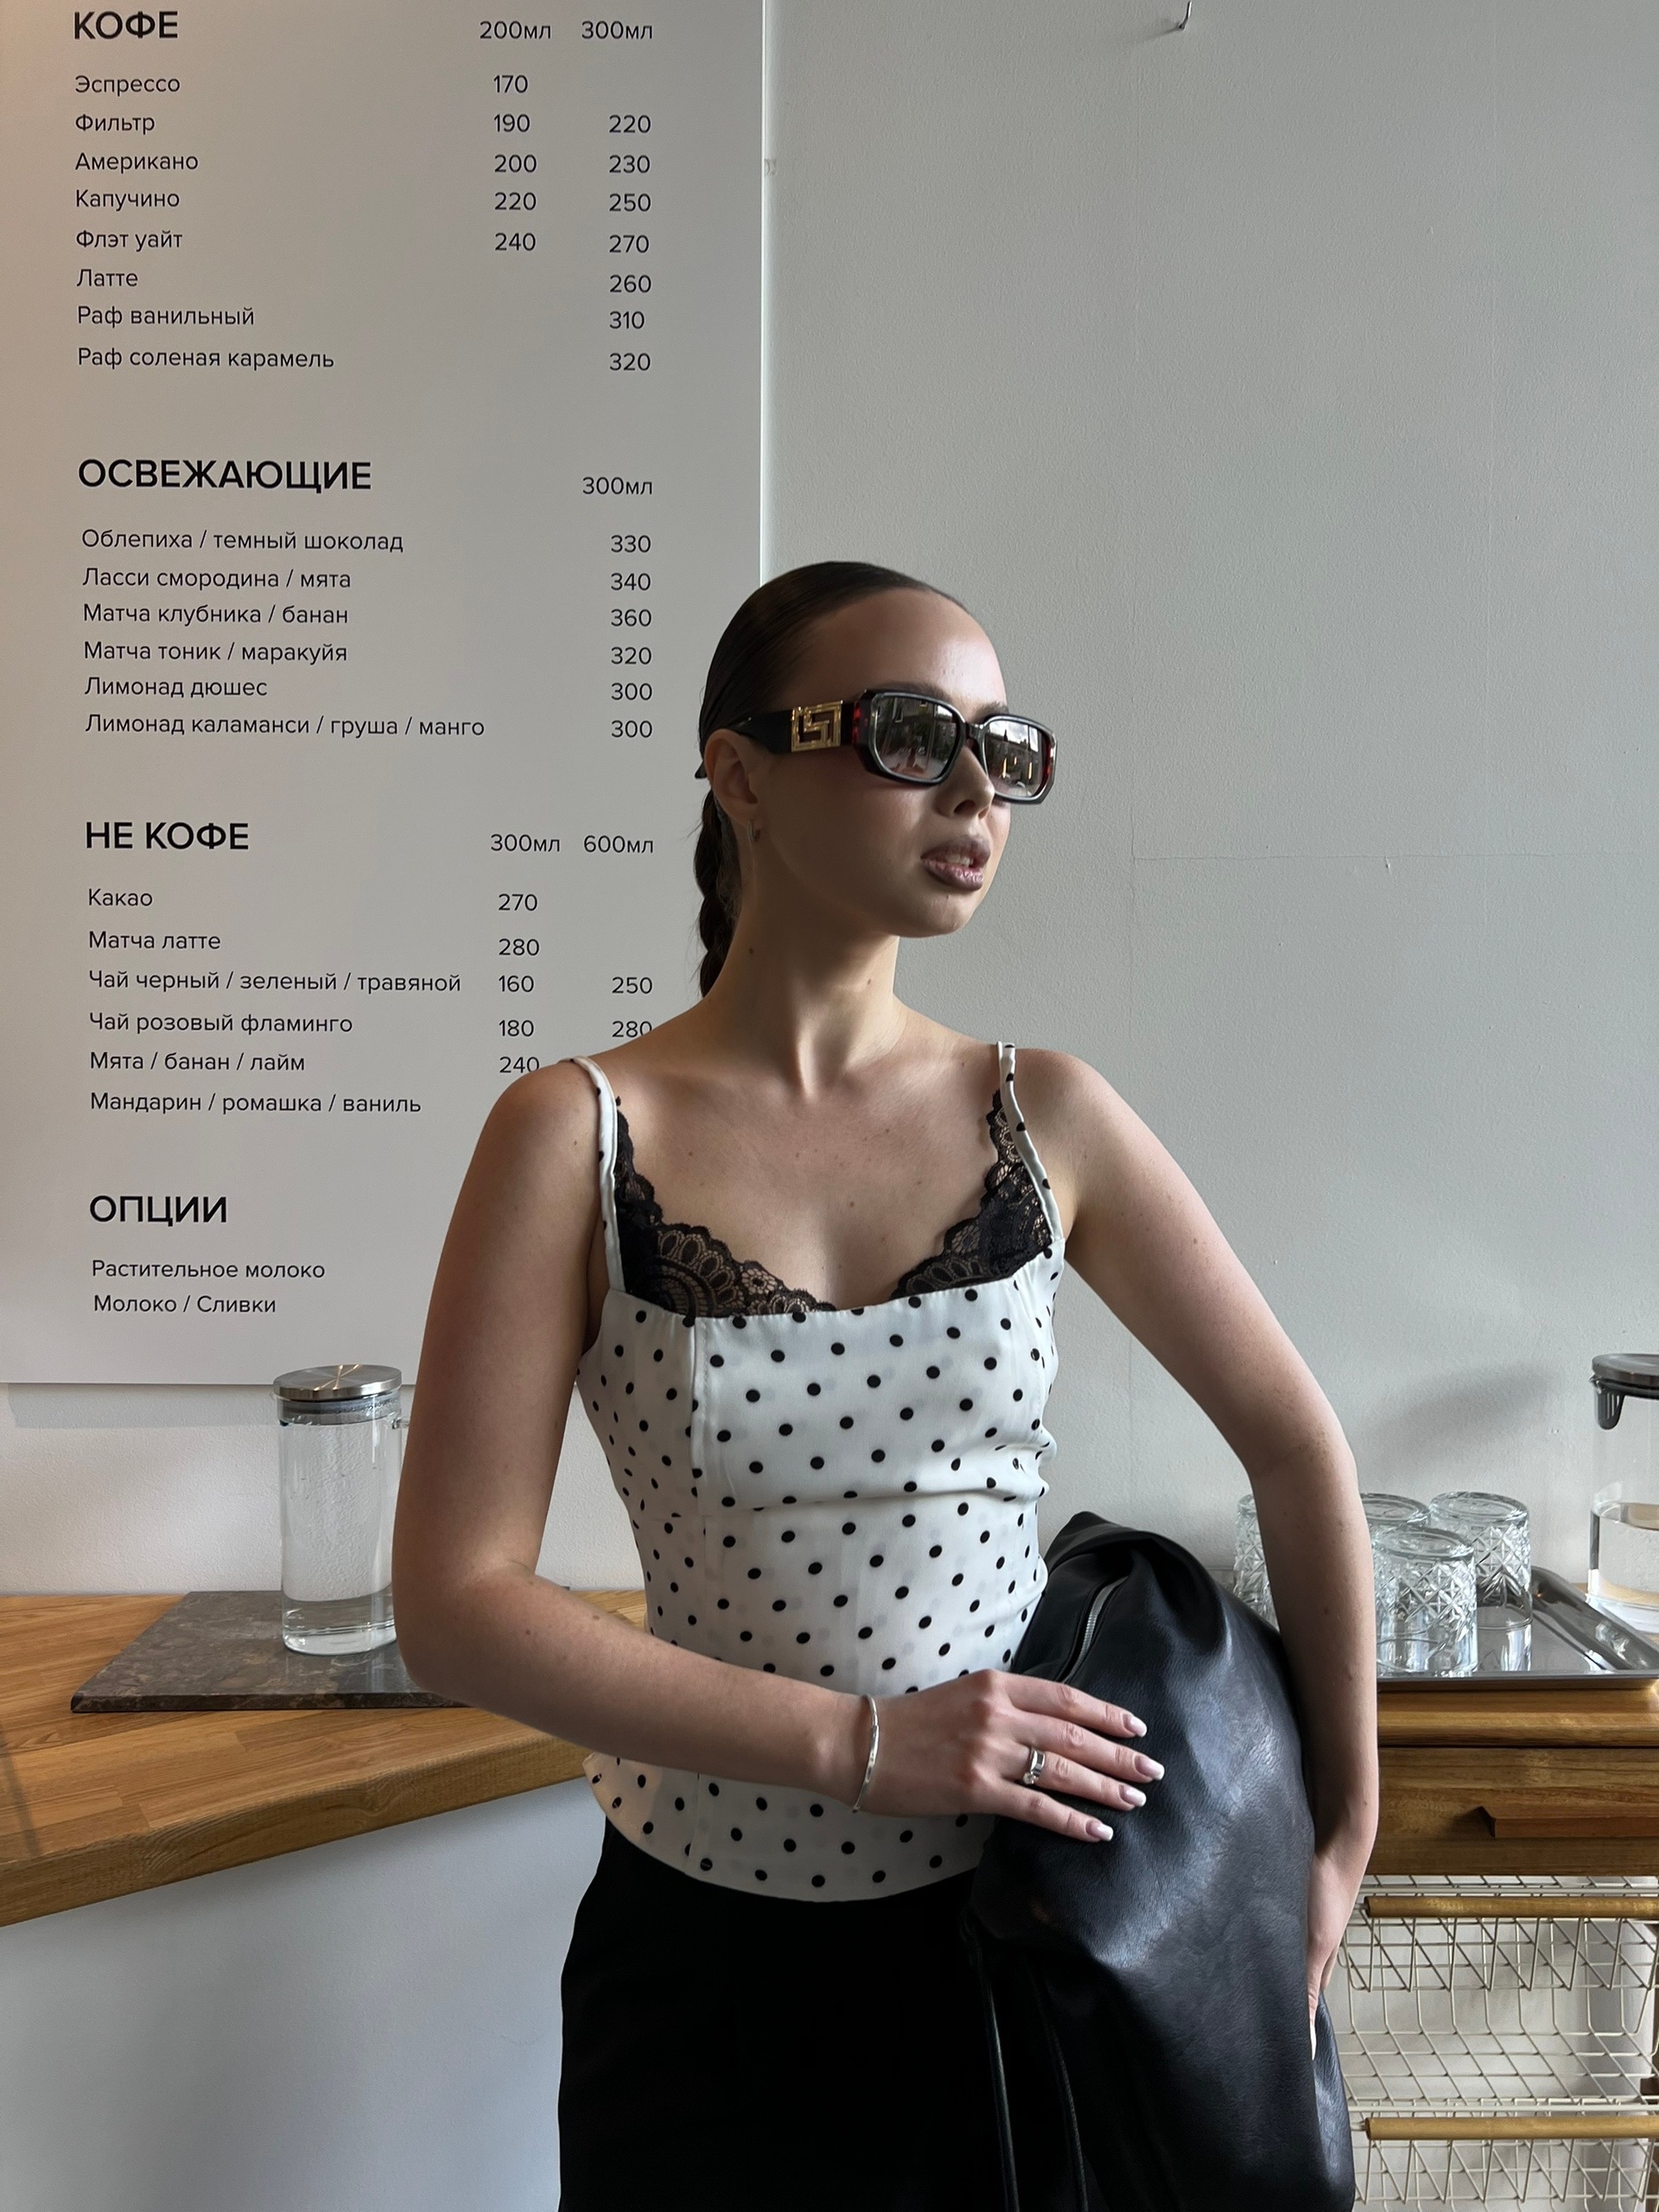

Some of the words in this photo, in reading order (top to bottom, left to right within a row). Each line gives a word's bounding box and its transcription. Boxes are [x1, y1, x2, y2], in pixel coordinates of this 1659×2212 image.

[73, 10, 179, 41] КОФЕ
[480, 20, 551, 40] 200мл
[581, 20, 653, 40] 300мл
[74, 74, 181, 98] Эспрессо
[493, 74, 529, 94] 170
[75, 113, 156, 136] Фильтр
[493, 113, 531, 133] 190
[608, 114, 652, 134] 220
[74, 151, 199, 175] Американо
[493, 153, 537, 174] 200
[608, 154, 651, 174] 230
[76, 188, 180, 213] Капучино
[494, 191, 537, 211] 220
[608, 193, 652, 213] 250
[76, 229, 129, 251] Флэт
[134, 229, 183, 253] уайт
[494, 232, 537, 252] 240
[608, 234, 650, 254] 270
[76, 268, 138, 288] Латте
[609, 274, 652, 294] 260
[78, 305, 123, 329] Раф
[130, 306, 254, 326] ванильный
[609, 310, 645, 330] 310
[78, 346, 123, 371] Раф
[129, 351, 220, 367] соленая
[228, 352, 334, 372] карамель
[609, 352, 652, 372] 320
[78, 458, 372, 495] ОСВЕЖАЮЩИЕ
[582, 476, 653, 496] 300мл
[81, 528, 193, 549] Облепиха
[199, 529, 207, 550] /
[213, 531, 296, 550] темный
[304, 535, 404, 554] шоколад
[610, 534, 652, 554] 330
[81, 567, 149, 587] Ласси
[156, 572, 279, 592] смородина
[285, 568, 295, 588] /
[301, 573, 351, 588] мята
[610, 572, 652, 592] 340
[83, 602, 150, 622] Матча
[158, 603, 261, 627] клубника
[267, 603, 276, 624] /
[282, 604, 348, 624] банан
[610, 608, 652, 627] 360
[84, 640, 151, 660] Матча
[157, 645, 222, 661] тоник
[226, 641, 236, 661] /
[241, 643, 347, 666] маракуйя
[610, 645, 652, 665] 320
[84, 676, 185, 699] Лимонад
[190, 682, 268, 699] дюшес
[611, 682, 653, 702] 300
[85, 713, 185, 736] Лимонад
[192, 718, 309, 734] каламанси
[315, 715, 325, 734] /
[331, 720, 398, 740] груша
[404, 715, 413, 735] /
[419, 721, 485, 736] манго
[611, 719, 653, 739] 300
[86, 821, 134, 849] НЕ
[145, 821, 249, 850] КОФЕ
[490, 833, 561, 853] 300мл
[583, 835, 654, 854] 600мл
[88, 887, 153, 907] Какао
[498, 893, 538, 912] 270
[89, 930, 155, 950] Матча
[161, 935, 221, 950] латте
[498, 938, 540, 957] 280
[89, 969, 129, 988] Чай
[136, 971, 219, 994] черный
[226, 970, 234, 989] /
[239, 972, 337, 990] зеленый
[343, 971, 352, 991] /
[357, 974, 461, 995] травяной
[498, 975, 535, 993] 160
[612, 976, 653, 995] 250
[89, 1012, 130, 1031] Чай
[137, 1014, 233, 1035] розовый
[240, 1013, 353, 1036] фламинго
[499, 1019, 535, 1038] 180
[611, 1020, 653, 1038] 280
[90, 1051, 144, 1070] Мята
[149, 1051, 159, 1071] /
[164, 1052, 230, 1071] банан
[236, 1052, 245, 1071] /
[249, 1052, 305, 1071] лайм
[499, 1055, 540, 1074] 240
[91, 1091, 201, 1115] Мандарин
[207, 1092, 217, 1111] /
[222, 1096, 321, 1116] ромашка
[327, 1093, 337, 1112] /
[343, 1098, 422, 1113] ваниль
[89, 1194, 227, 1228] ОПЦИИ
[92, 1259, 238, 1278] Растительное
[245, 1264, 326, 1279] молоко
[93, 1294, 177, 1313] Молоко
[182, 1294, 191, 1313] /
[196, 1294, 276, 1313] Сливки
